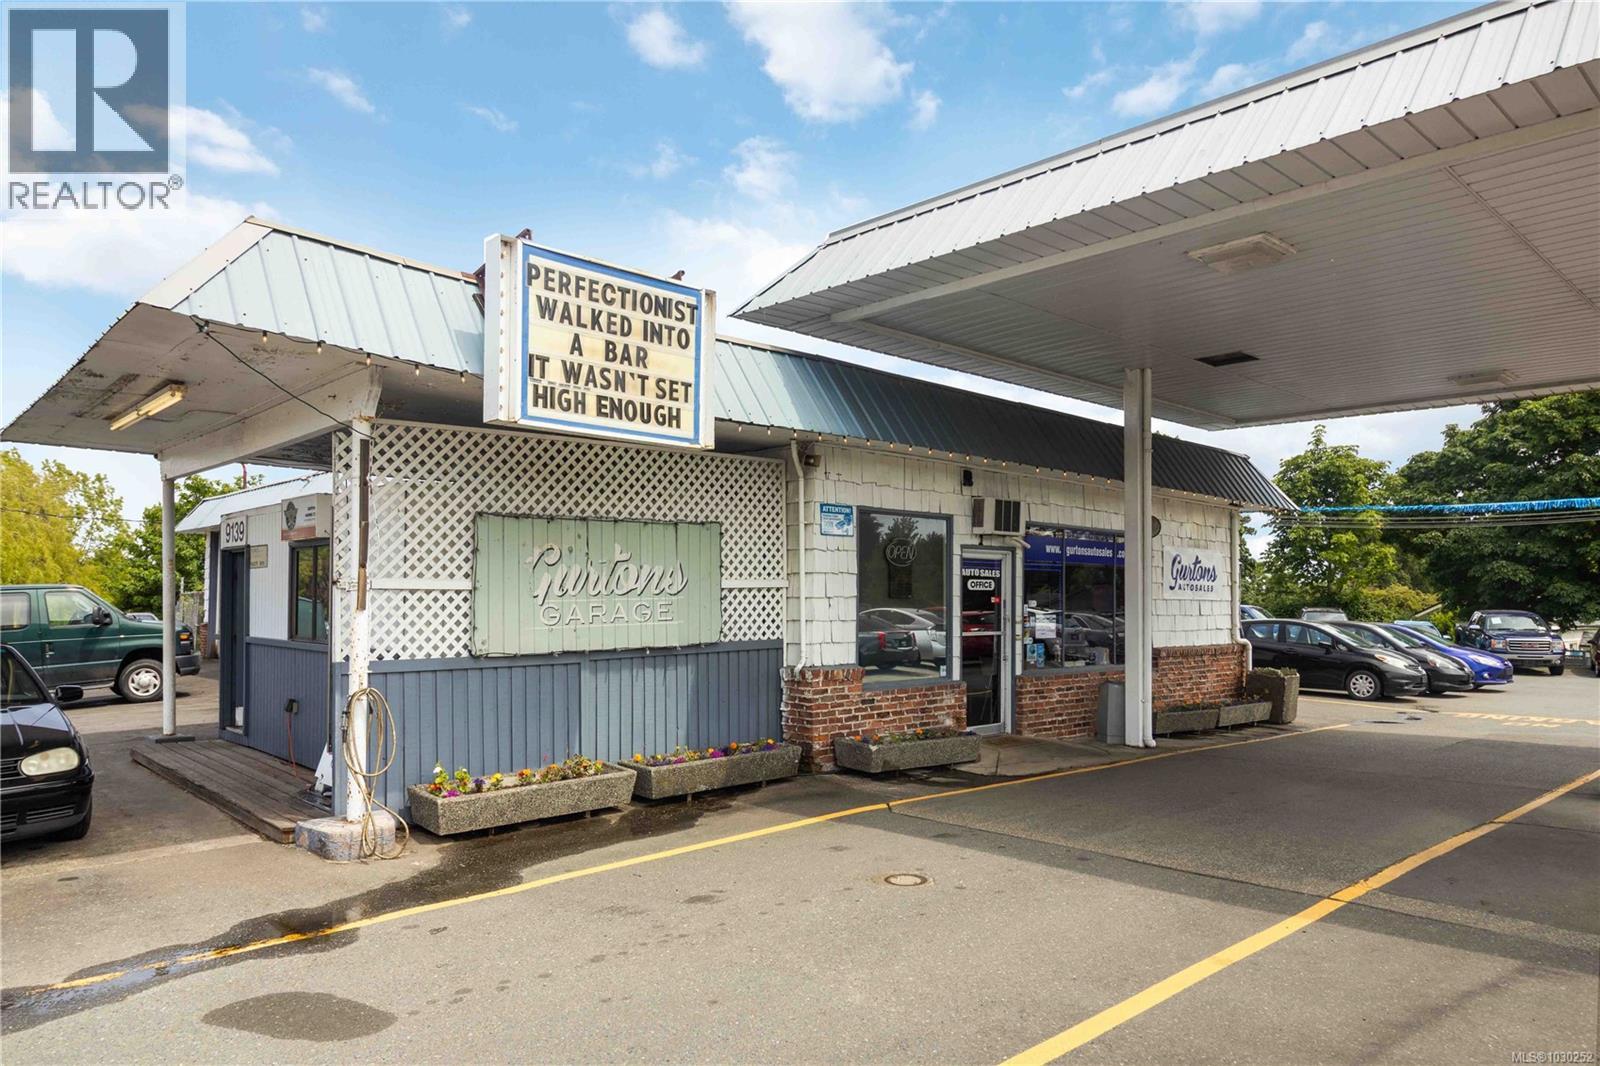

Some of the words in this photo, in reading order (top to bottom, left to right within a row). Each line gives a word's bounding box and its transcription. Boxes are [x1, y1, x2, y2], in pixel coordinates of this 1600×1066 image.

[527, 262, 698, 325] PERFECTIONIST
[536, 294, 632, 338] WALKED
[643, 320, 690, 350] INTO
[569, 333, 583, 357] A
[605, 340, 648, 369] BAR
[528, 353, 550, 379] IT
[655, 377, 692, 403] SET
[532, 383, 586, 415] HIGH
[596, 394, 681, 429] ENOUGH
[225, 521, 245, 543] 9139
[888, 544, 915, 559] OPEN
[1045, 545, 1061, 554] www.
[1066, 545, 1113, 557] gurtonsautosales
[1116, 550, 1125, 559] .co
[524, 543, 689, 607] Gurtons
[962, 568, 980, 577] AUTO
[980, 569, 1001, 578] SALES
[970, 581, 993, 589] OFFICE
[1169, 554, 1217, 590] Gurtons
[1178, 584, 1214, 592] AUTOSALES
[540, 601, 674, 626] GARAGE
